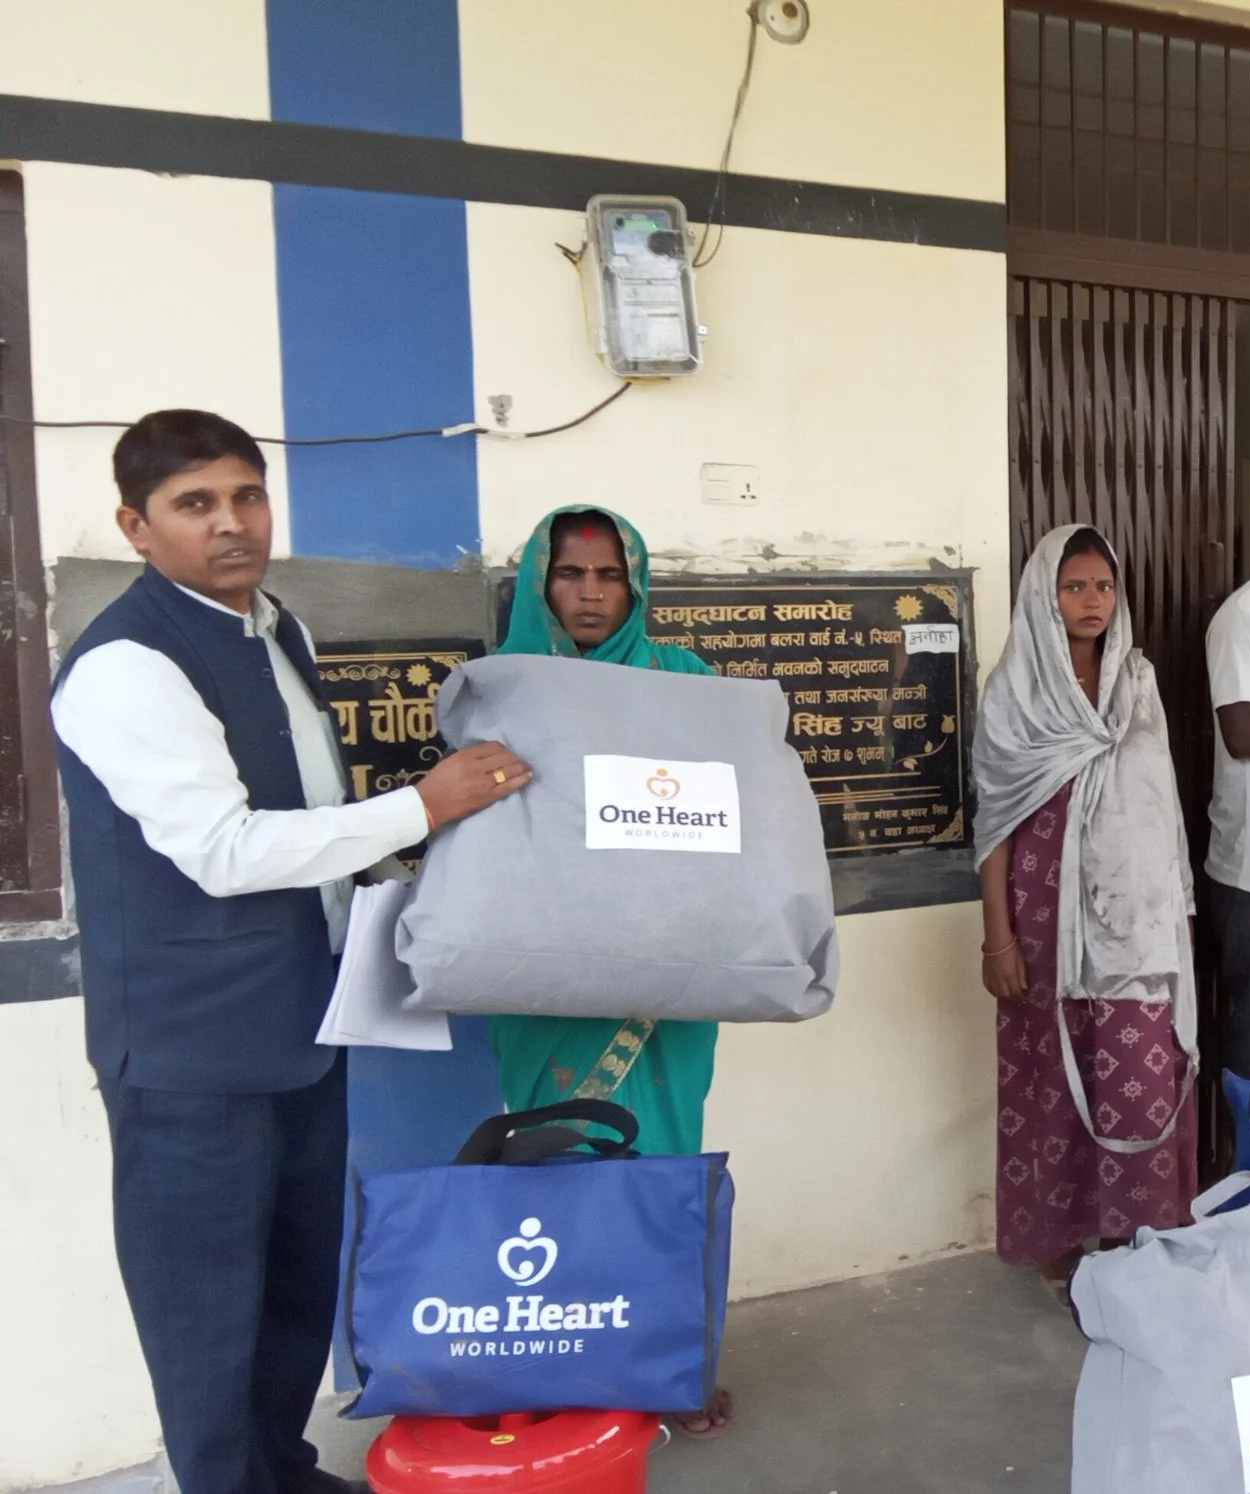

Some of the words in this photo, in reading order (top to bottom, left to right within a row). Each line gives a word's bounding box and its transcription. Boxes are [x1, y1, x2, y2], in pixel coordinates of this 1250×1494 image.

[773, 600, 853, 622] समारोह
[699, 630, 766, 650] सहयोगमा
[770, 632, 805, 646] बलरा
[809, 627, 831, 646] वार्ड
[870, 628, 902, 644] स्थित
[727, 658, 768, 677] निर्मित
[772, 657, 822, 676] भवनको
[794, 690, 821, 705] तथा
[826, 686, 887, 704] जनसंख्या
[892, 684, 927, 700] मन्त्री
[793, 712, 844, 737] सिंह
[892, 714, 928, 730] बाट
[821, 744, 840, 763] रोज
[843, 749, 853, 762] ७
[600, 805, 651, 824] One
[656, 806, 728, 828] Heart
[625, 829, 703, 840] WORLDWIDE
[412, 1297, 499, 1334] One
[503, 1295, 630, 1332] Heart
[450, 1339, 585, 1357] WORLDWIDE
